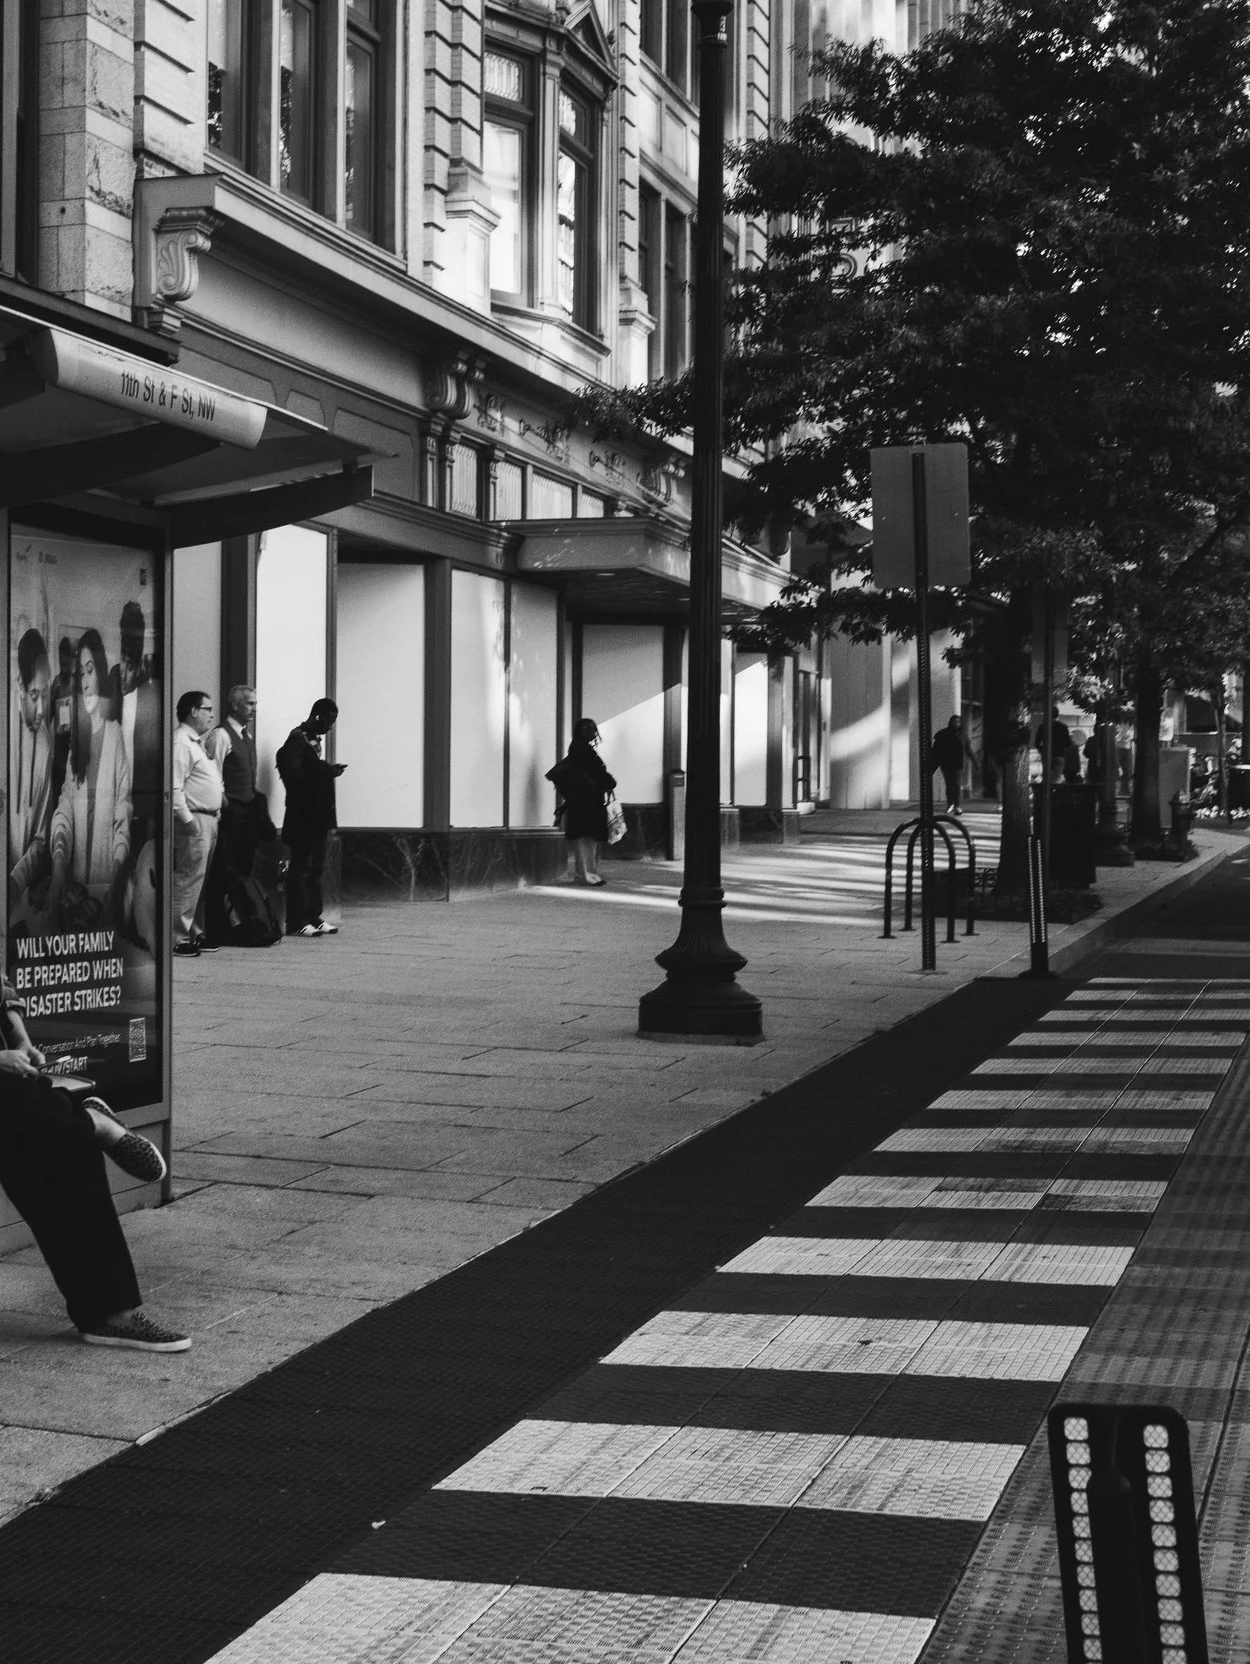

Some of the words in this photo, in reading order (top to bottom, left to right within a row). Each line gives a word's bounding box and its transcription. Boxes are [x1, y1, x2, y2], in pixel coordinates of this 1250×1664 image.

[121, 370, 140, 399] 11th
[143, 375, 155, 404] St
[159, 382, 167, 407] &
[170, 384, 177, 409] F
[182, 388, 194, 420] St,
[198, 393, 216, 421] NW
[16, 936, 45, 959] WILL
[45, 933, 77, 957] YOUR
[78, 931, 115, 953] FAMILY
[16, 966, 32, 989] BE
[34, 961, 91, 987] PREPARED
[92, 957, 123, 981] WHEN
[73, 985, 121, 1011] STRIKES?
